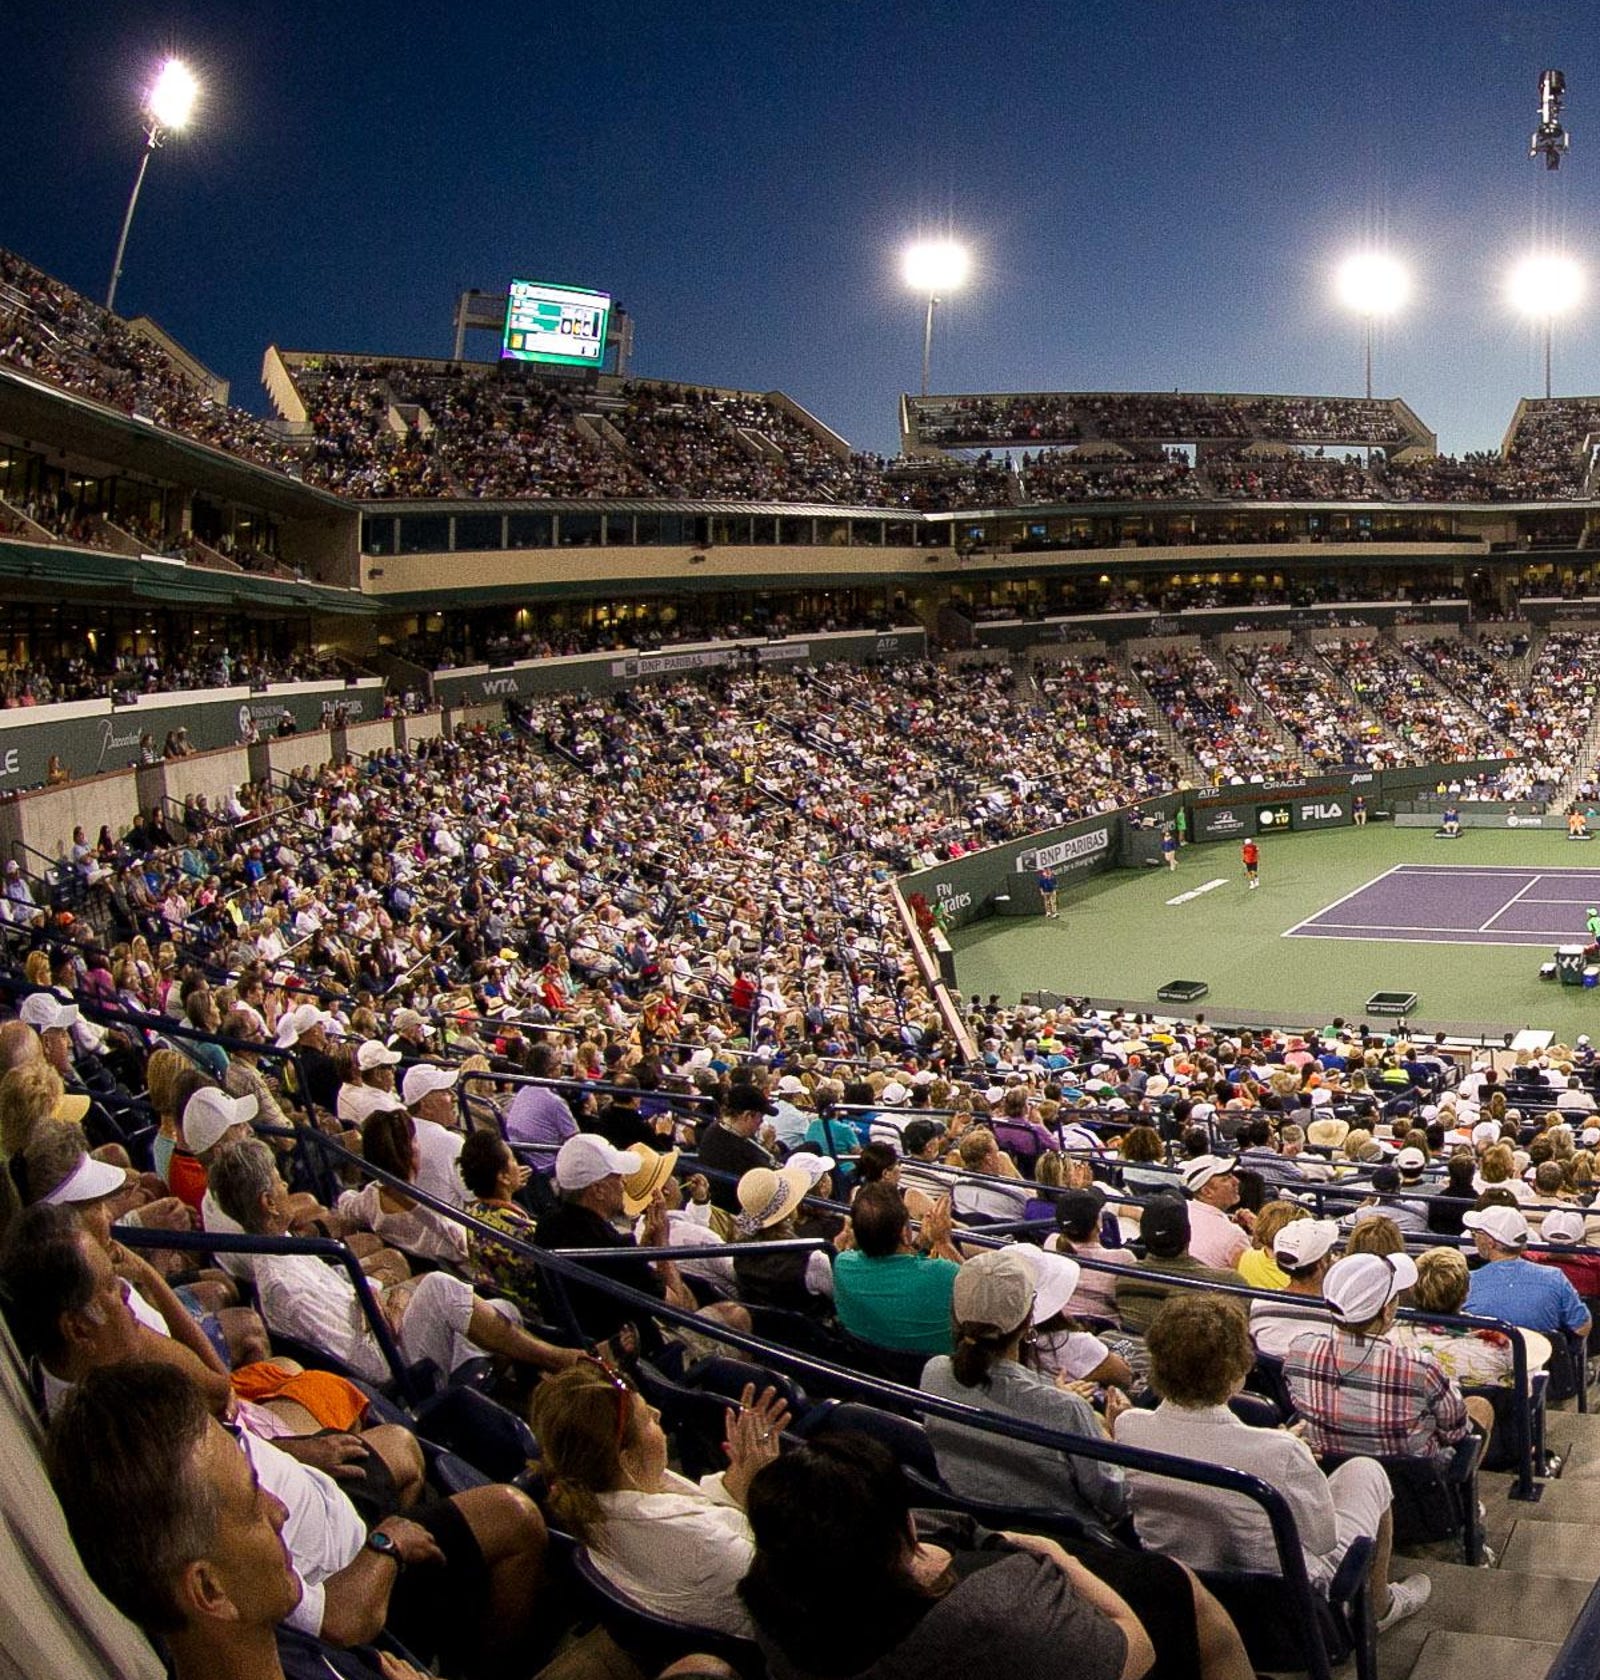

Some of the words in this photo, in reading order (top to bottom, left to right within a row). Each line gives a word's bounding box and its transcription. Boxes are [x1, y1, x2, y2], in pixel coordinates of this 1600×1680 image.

[877, 637, 898, 649] ATP
[640, 658, 662, 673] BNP
[663, 655, 704, 669] PARIBAS
[481, 678, 519, 696] WTA
[1198, 788, 1220, 798] ATP
[1262, 779, 1306, 790] ORACLE
[1301, 803, 1343, 820] FILA
[1041, 846, 1061, 866] BNP
[1064, 831, 1105, 858] PARIBAS
[936, 883, 952, 896] Fly
[944, 892, 972, 913] rates
